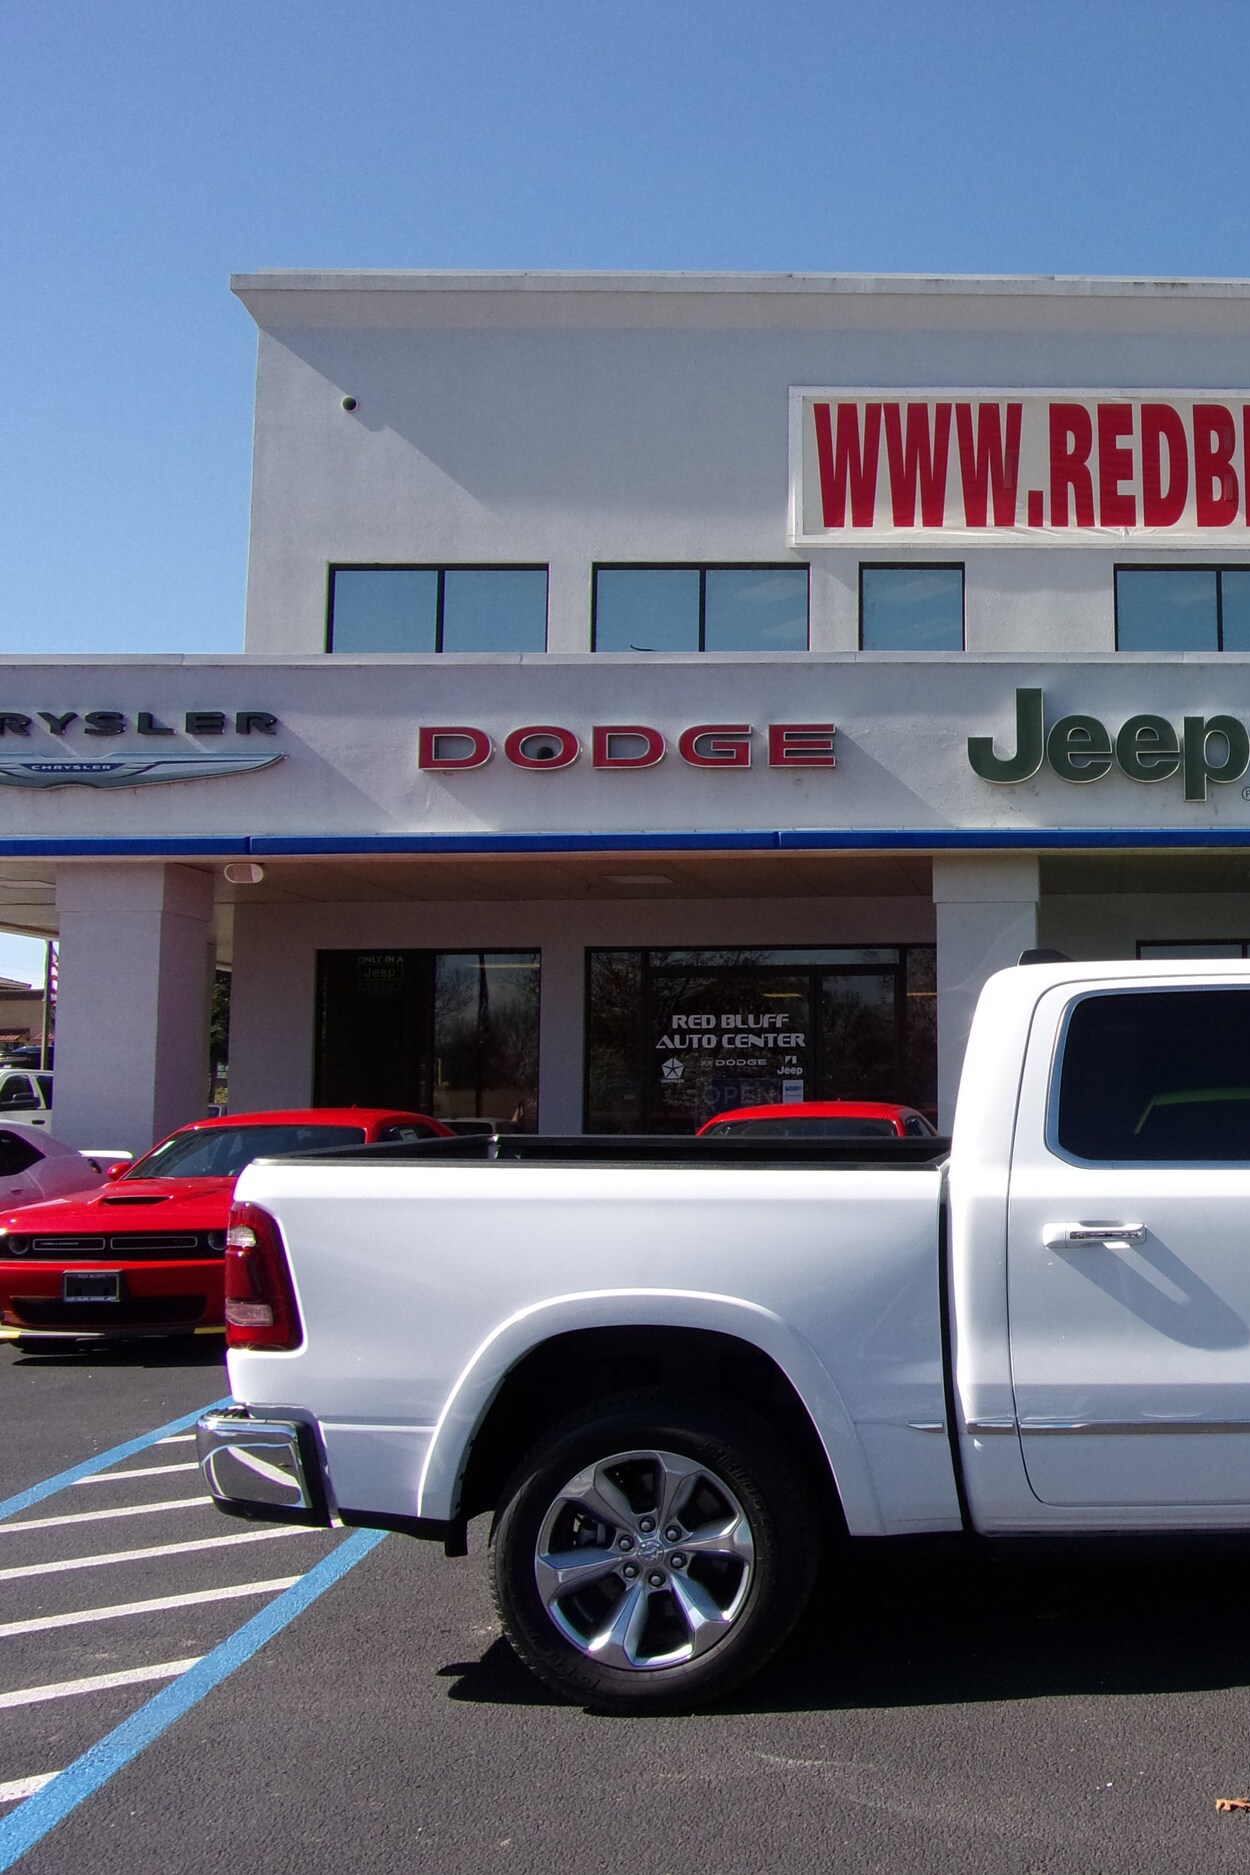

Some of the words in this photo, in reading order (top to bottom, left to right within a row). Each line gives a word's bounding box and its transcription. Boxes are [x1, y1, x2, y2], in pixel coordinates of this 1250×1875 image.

[418, 723, 837, 771] DODGE
[31, 764, 112, 772] CHRYSLER
[364, 968, 396, 978] Jeep
[672, 1014, 716, 1029] RED
[721, 1014, 790, 1028] BLUFF
[656, 1034, 717, 1049] AUTO
[722, 1033, 807, 1048] CENTER
[715, 1058, 768, 1067] DODGE
[777, 1065, 803, 1076] Jeep
